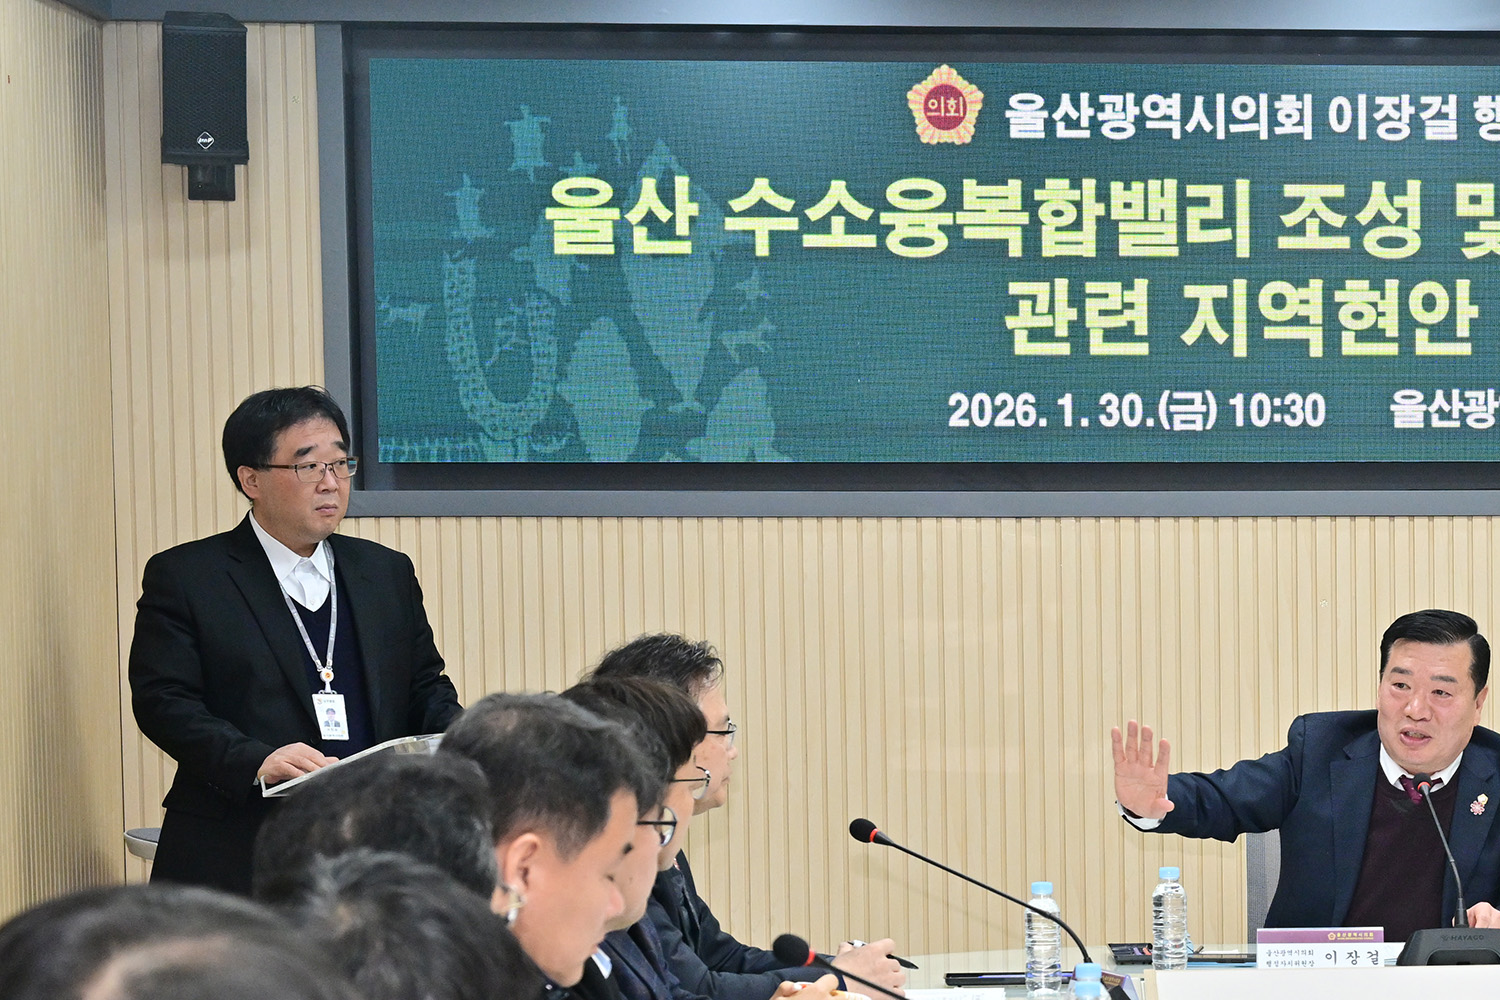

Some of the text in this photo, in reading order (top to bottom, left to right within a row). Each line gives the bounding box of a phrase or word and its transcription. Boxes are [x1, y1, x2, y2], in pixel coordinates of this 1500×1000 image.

[926, 96, 963, 117] 의회
[1005, 92, 1313, 141] 울산광역시의회
[1328, 93, 1458, 142] 이장걸
[545, 175, 699, 256] 울산
[724, 177, 1250, 258] 수소융복합밸리
[1277, 179, 1422, 259] 조성
[1005, 278, 1149, 357] 관련
[1180, 278, 1479, 359] 지역현안
[948, 392, 1047, 428] 2026.
[1229, 392, 1326, 428] 10:30
